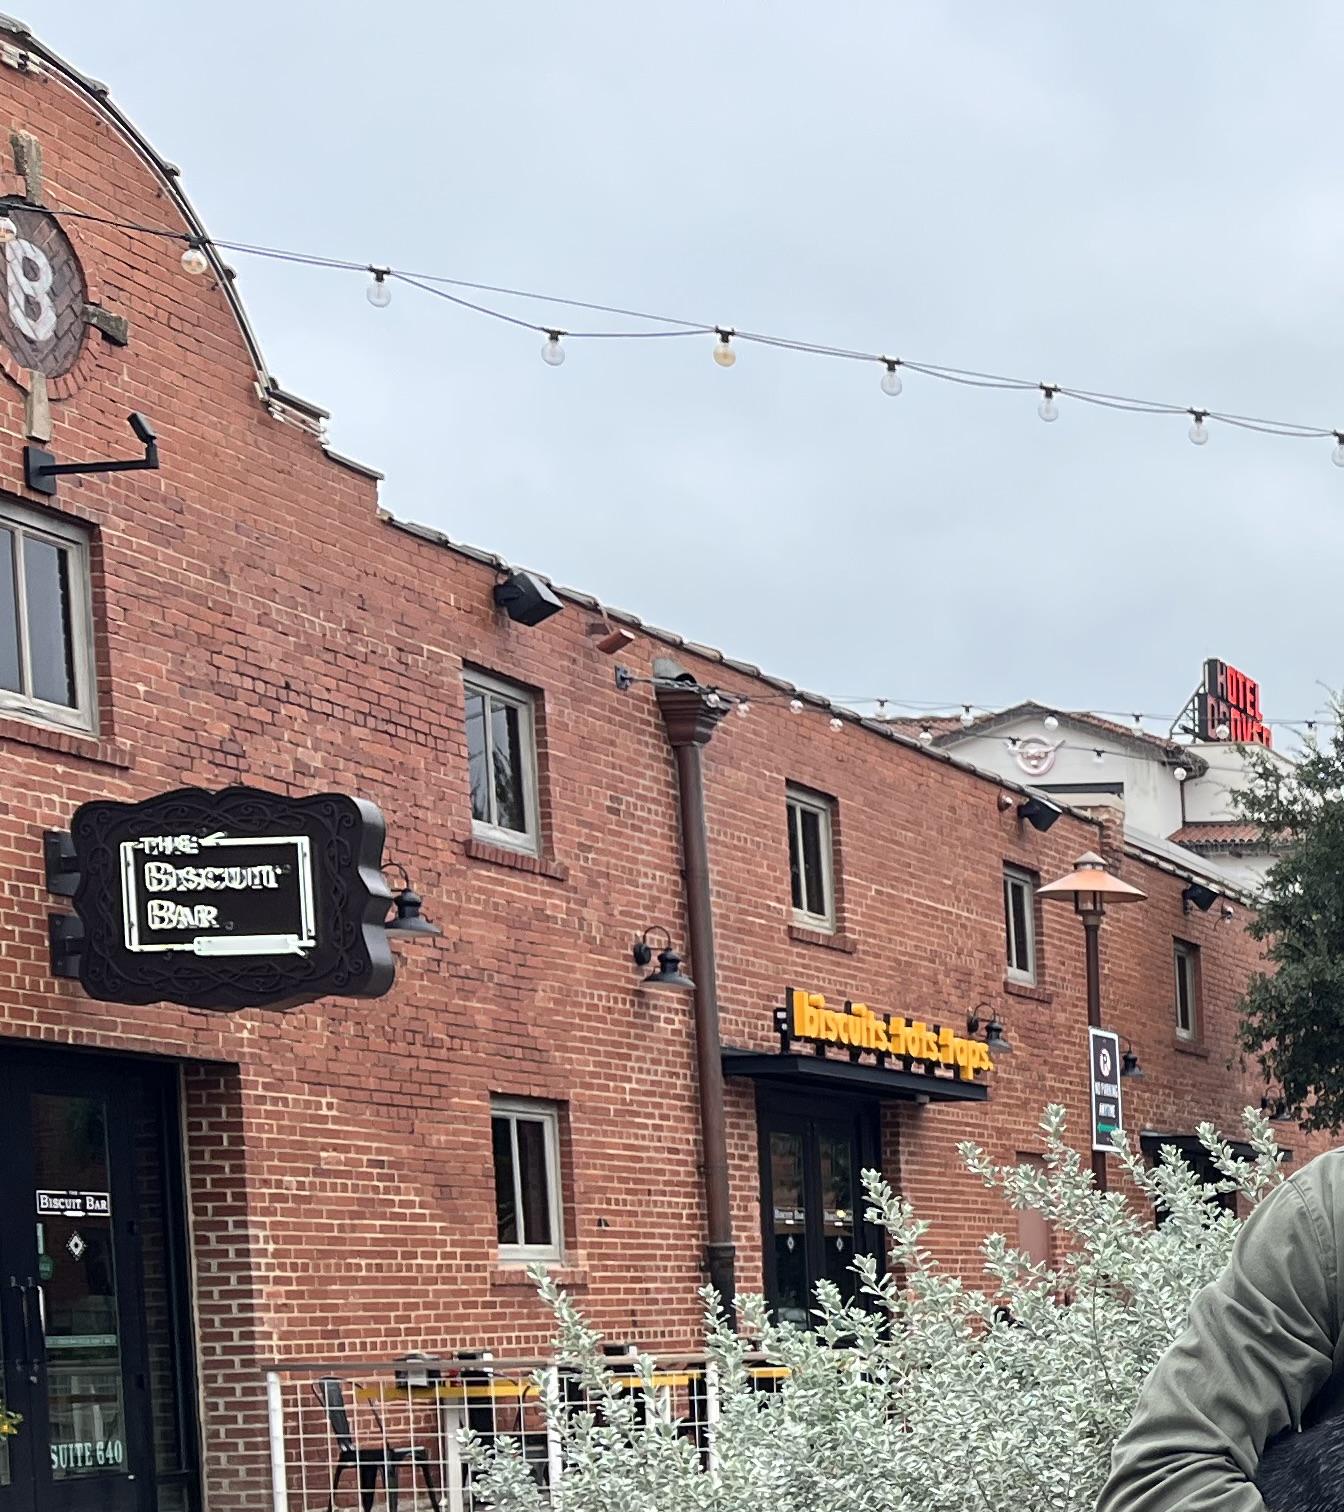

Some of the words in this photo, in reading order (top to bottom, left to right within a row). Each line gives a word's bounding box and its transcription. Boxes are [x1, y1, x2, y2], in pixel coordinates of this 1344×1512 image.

[1217, 660, 1263, 721] HOTEL
[50, 1443, 94, 1469] SUITE
[96, 1440, 123, 1465] 640
